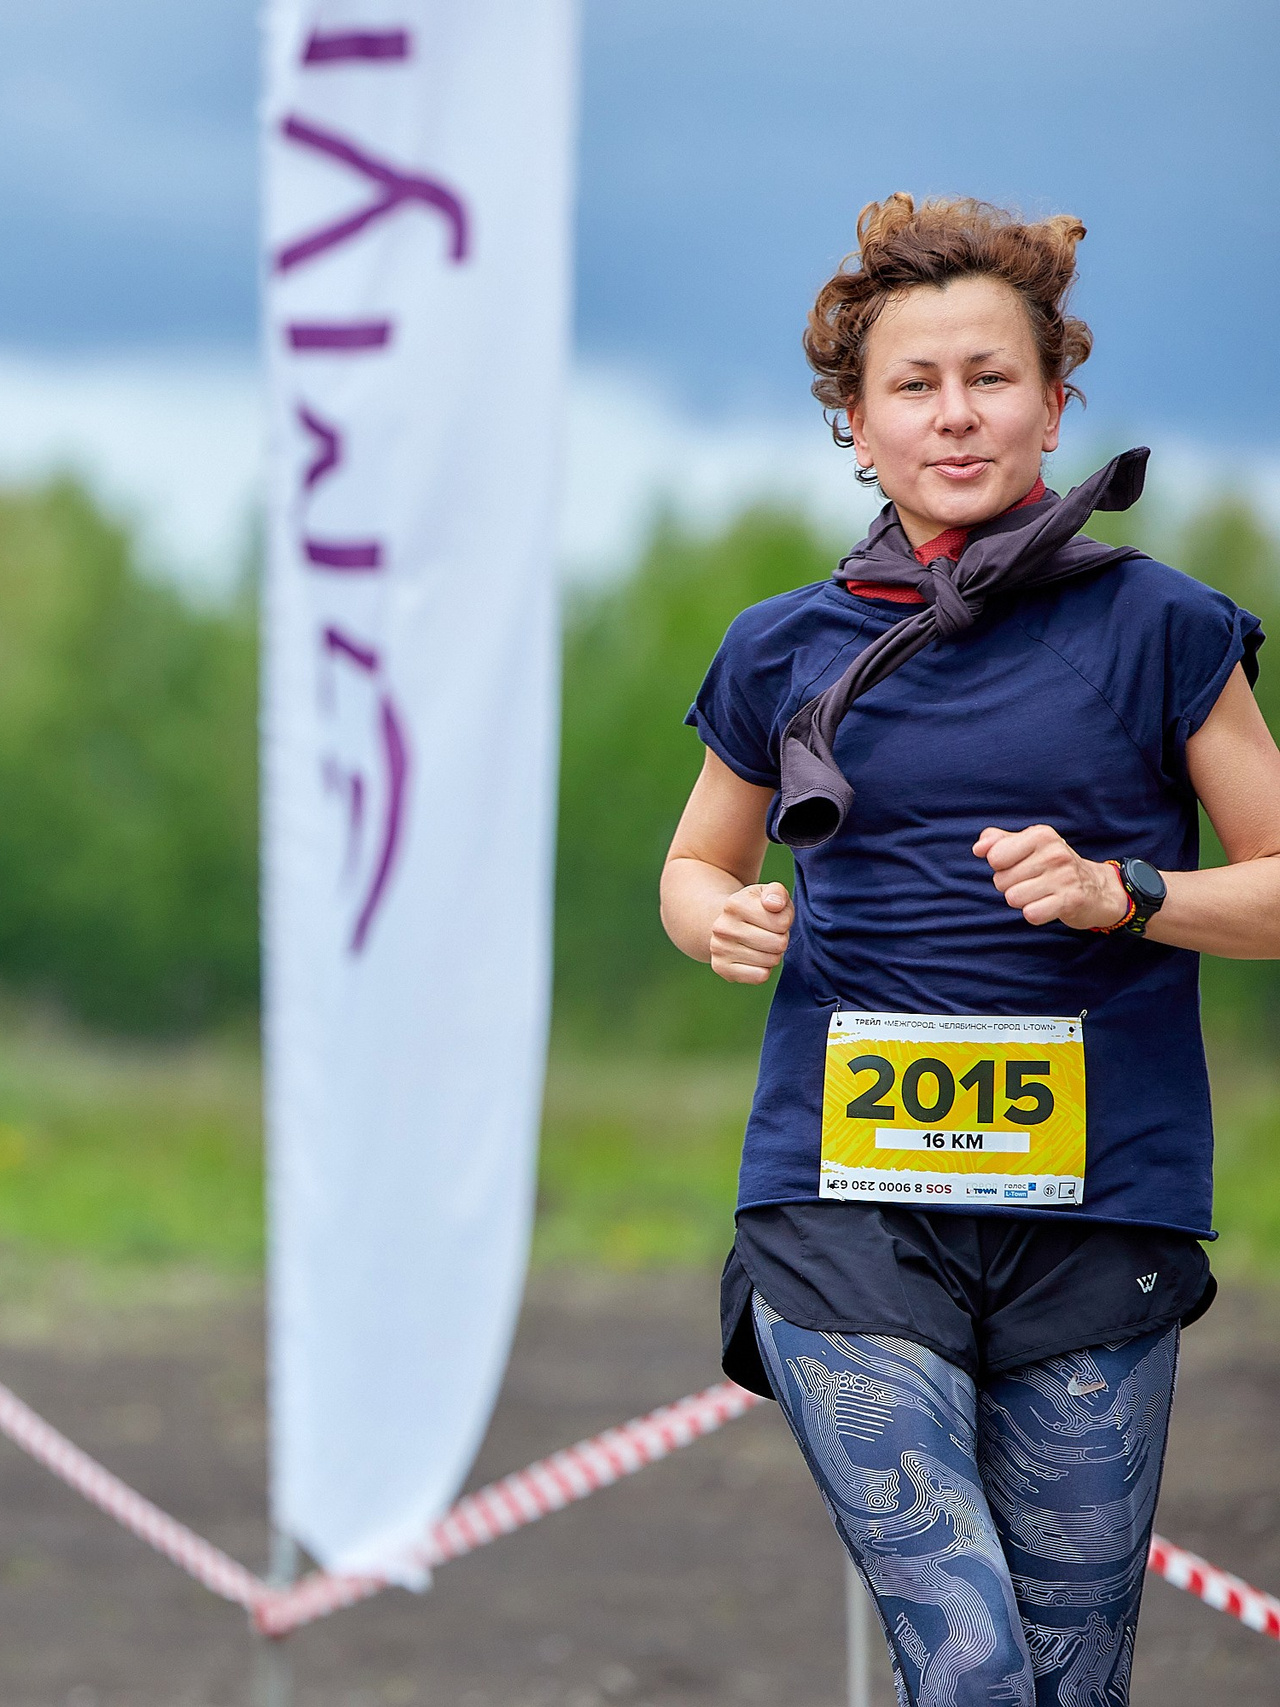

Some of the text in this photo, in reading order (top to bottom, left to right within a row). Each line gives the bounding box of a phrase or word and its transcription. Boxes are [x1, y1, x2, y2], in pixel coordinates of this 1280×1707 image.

[855, 1018, 881, 1026] ТРЕЙЛ
[846, 1054, 1055, 1125] 2015
[922, 1132, 945, 1148] 16
[851, 1180, 876, 1191] 230
[878, 1182, 911, 1193] 9000
[914, 1183, 923, 1193] 8
[926, 1184, 952, 1194] SOS
